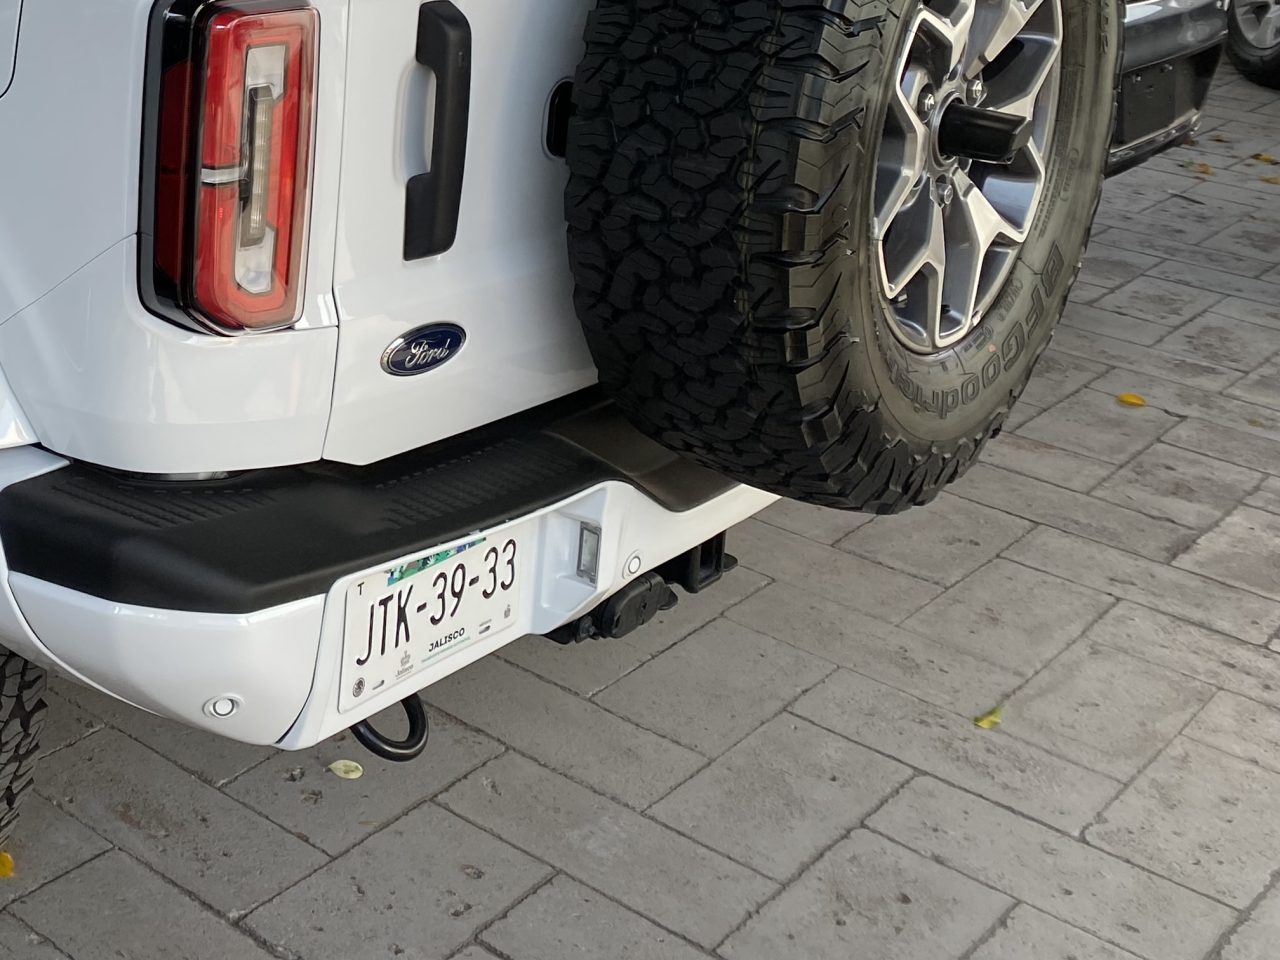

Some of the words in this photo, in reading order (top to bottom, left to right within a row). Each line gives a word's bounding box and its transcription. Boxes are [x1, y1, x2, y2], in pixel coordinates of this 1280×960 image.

[404, 338, 451, 368] Ford
[355, 538, 517, 667] JTK-39-33
[357, 581, 365, 596] T
[428, 627, 466, 653] JALISCO
